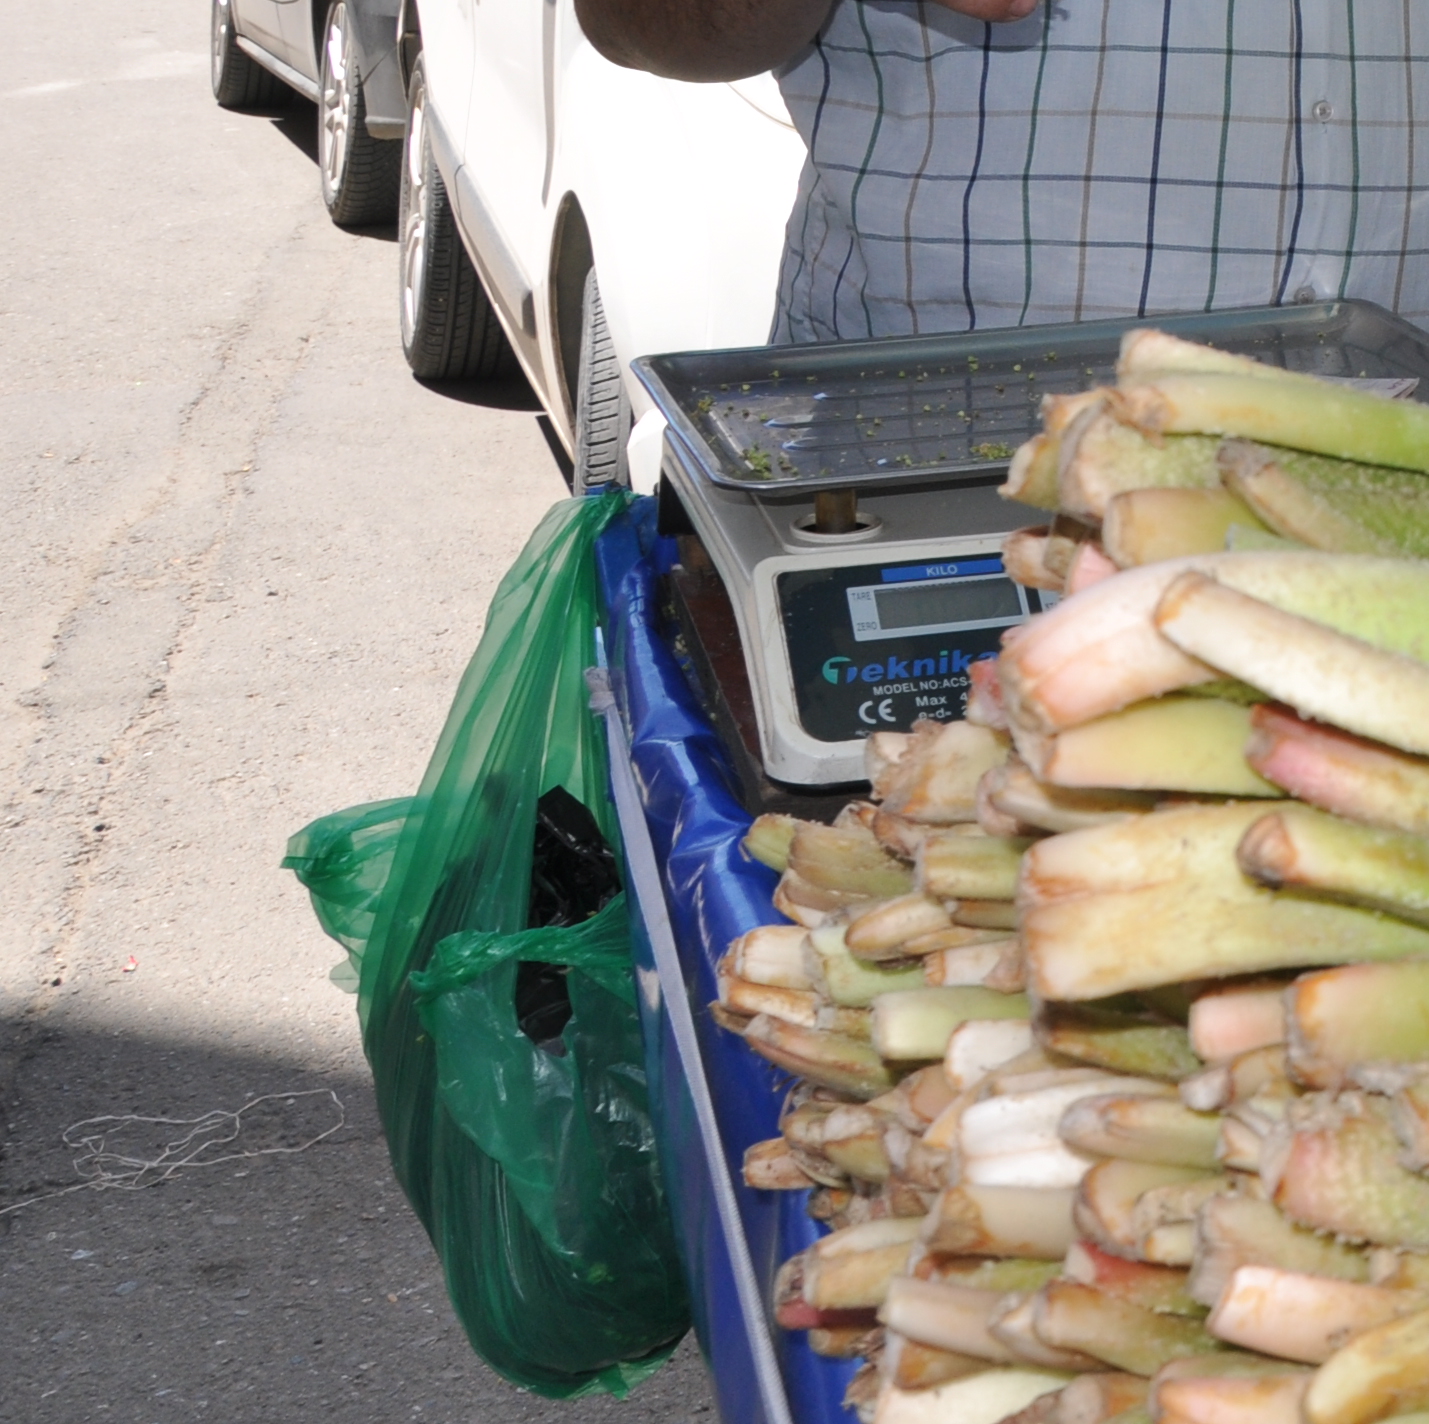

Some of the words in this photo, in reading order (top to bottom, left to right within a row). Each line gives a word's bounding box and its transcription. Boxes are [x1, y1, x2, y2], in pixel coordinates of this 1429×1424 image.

[925, 565, 958, 577] KILO
[850, 591, 872, 601] TARE
[856, 620, 878, 632] ZERO
[872, 683, 918, 697] MODEL
[915, 695, 947, 707] Max
